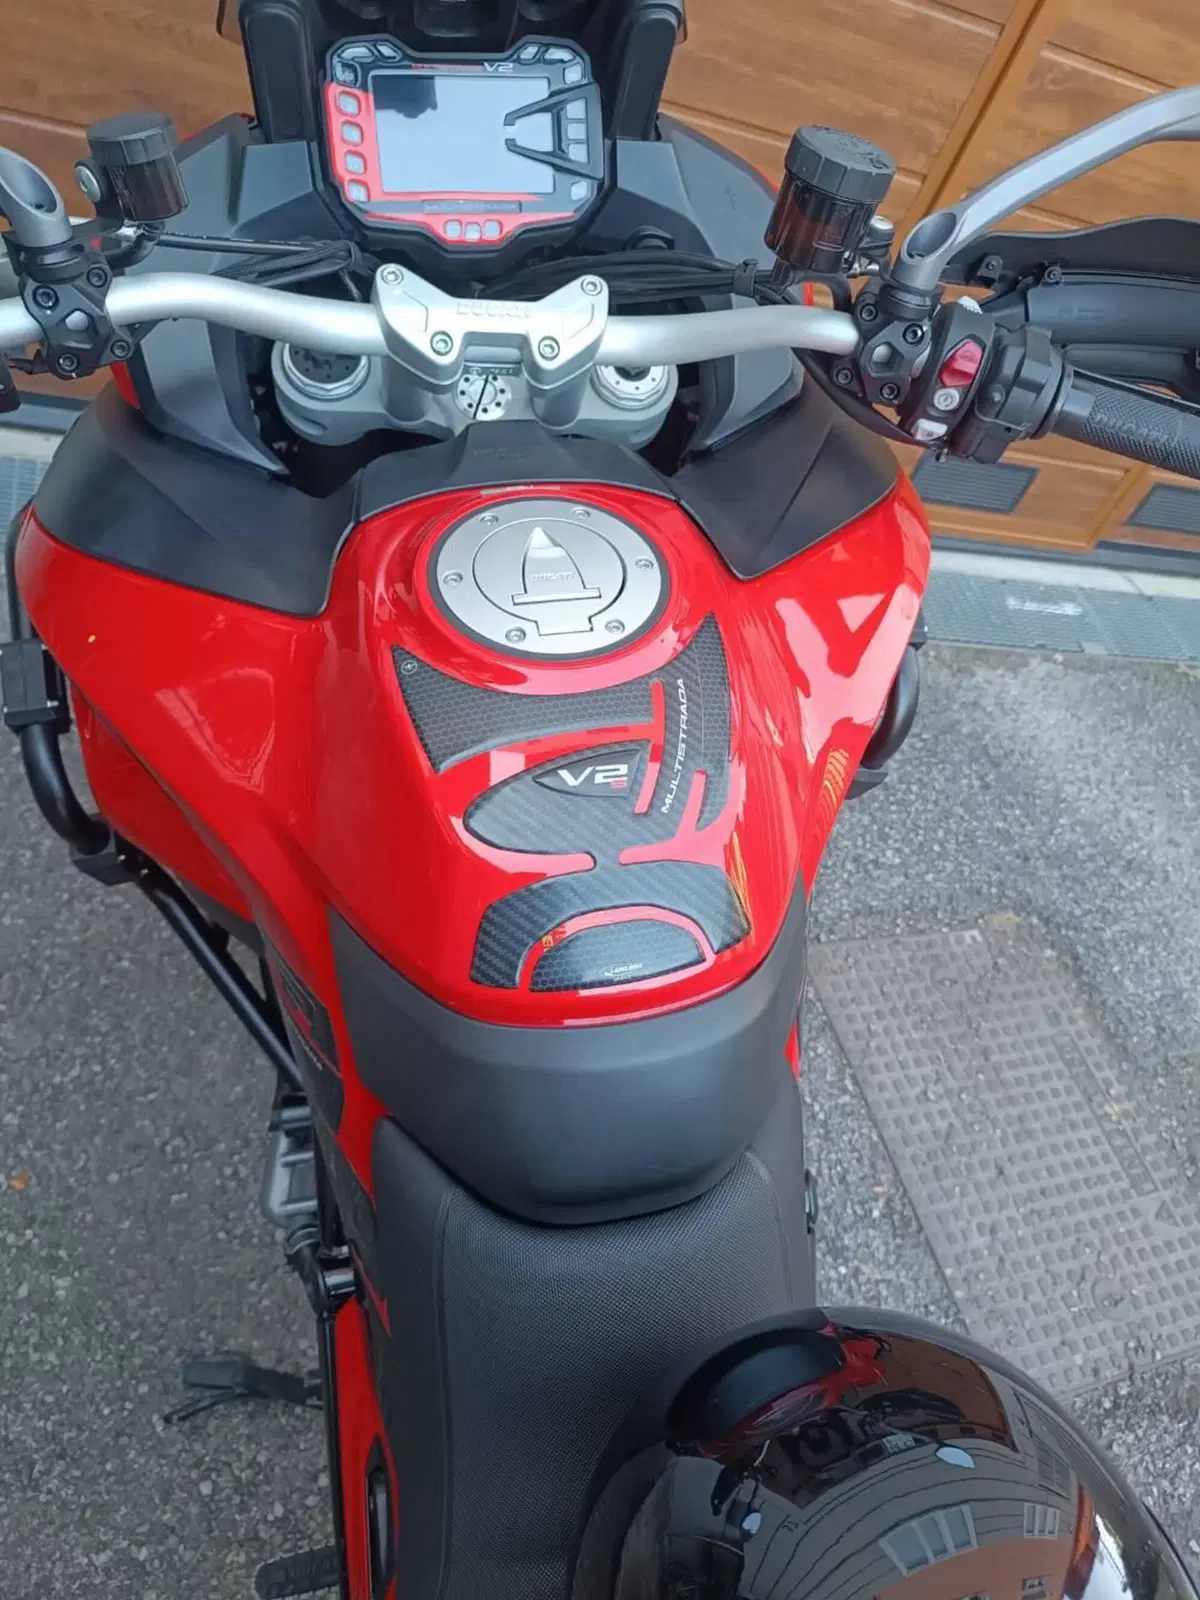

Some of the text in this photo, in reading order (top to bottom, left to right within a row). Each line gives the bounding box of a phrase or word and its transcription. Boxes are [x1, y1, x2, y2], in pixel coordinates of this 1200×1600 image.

[484, 61, 514, 72] V2
[661, 678, 688, 813] MULTISTRADA
[556, 763, 628, 787] V2
